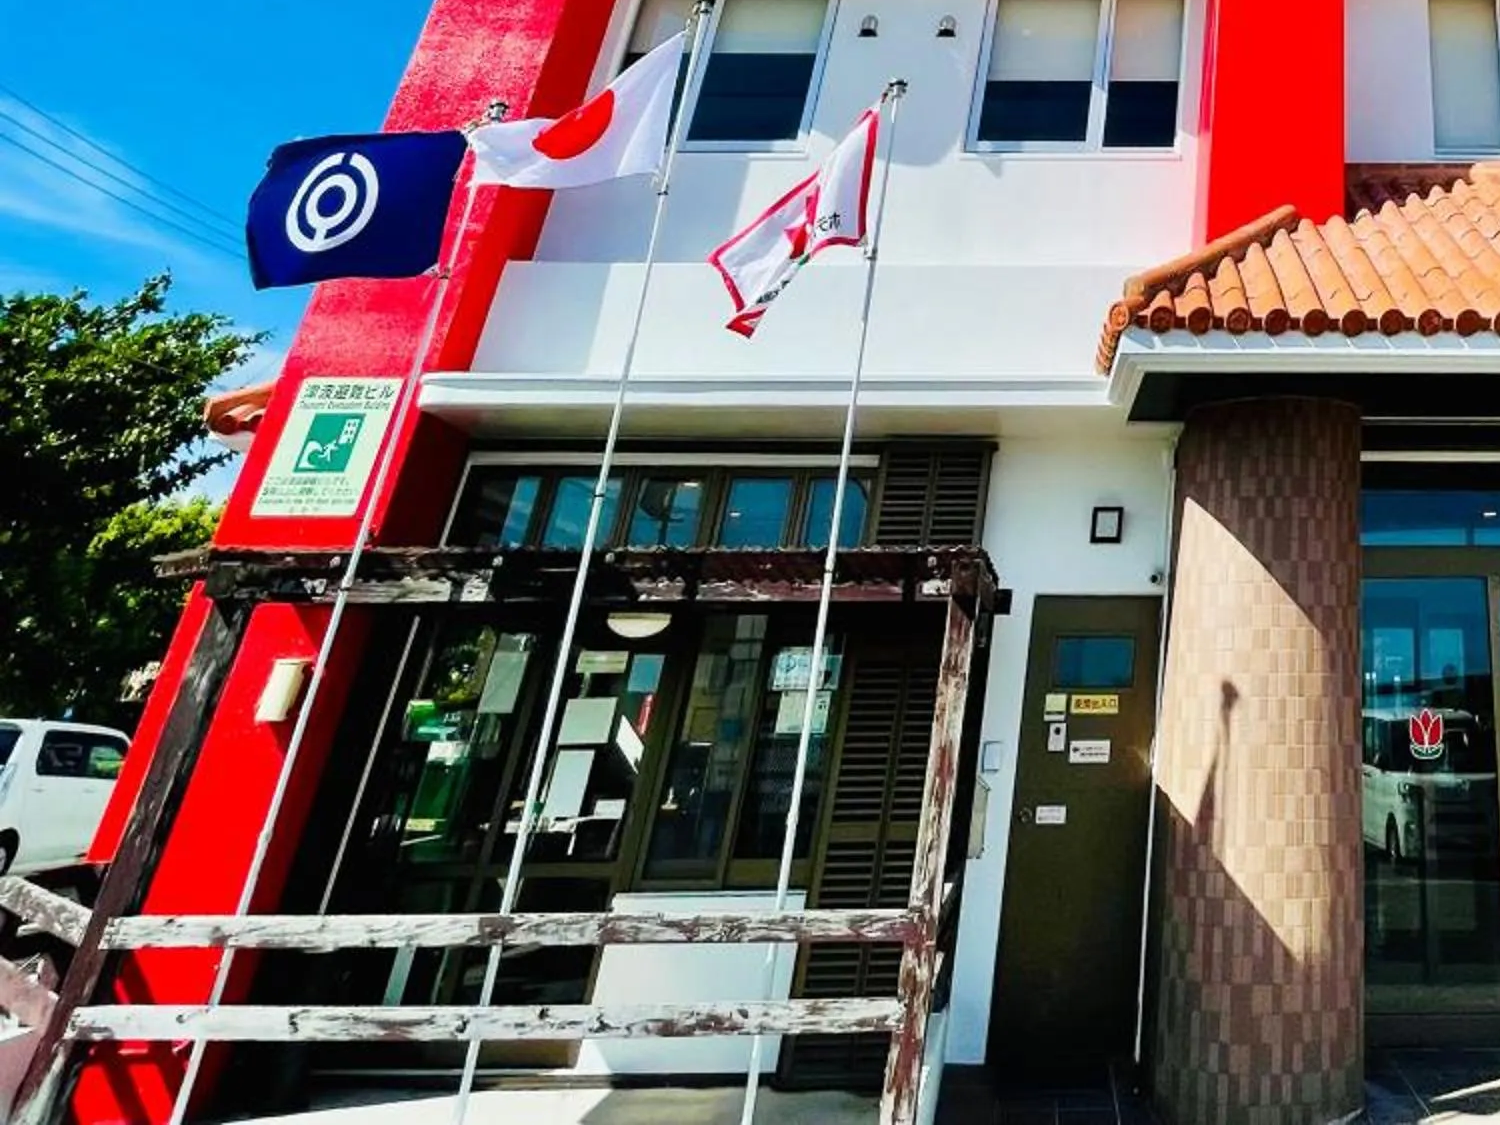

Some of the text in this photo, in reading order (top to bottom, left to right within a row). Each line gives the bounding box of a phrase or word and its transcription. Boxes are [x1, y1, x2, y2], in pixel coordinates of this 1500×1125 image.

[304, 384, 394, 399] 津波避難ビル
